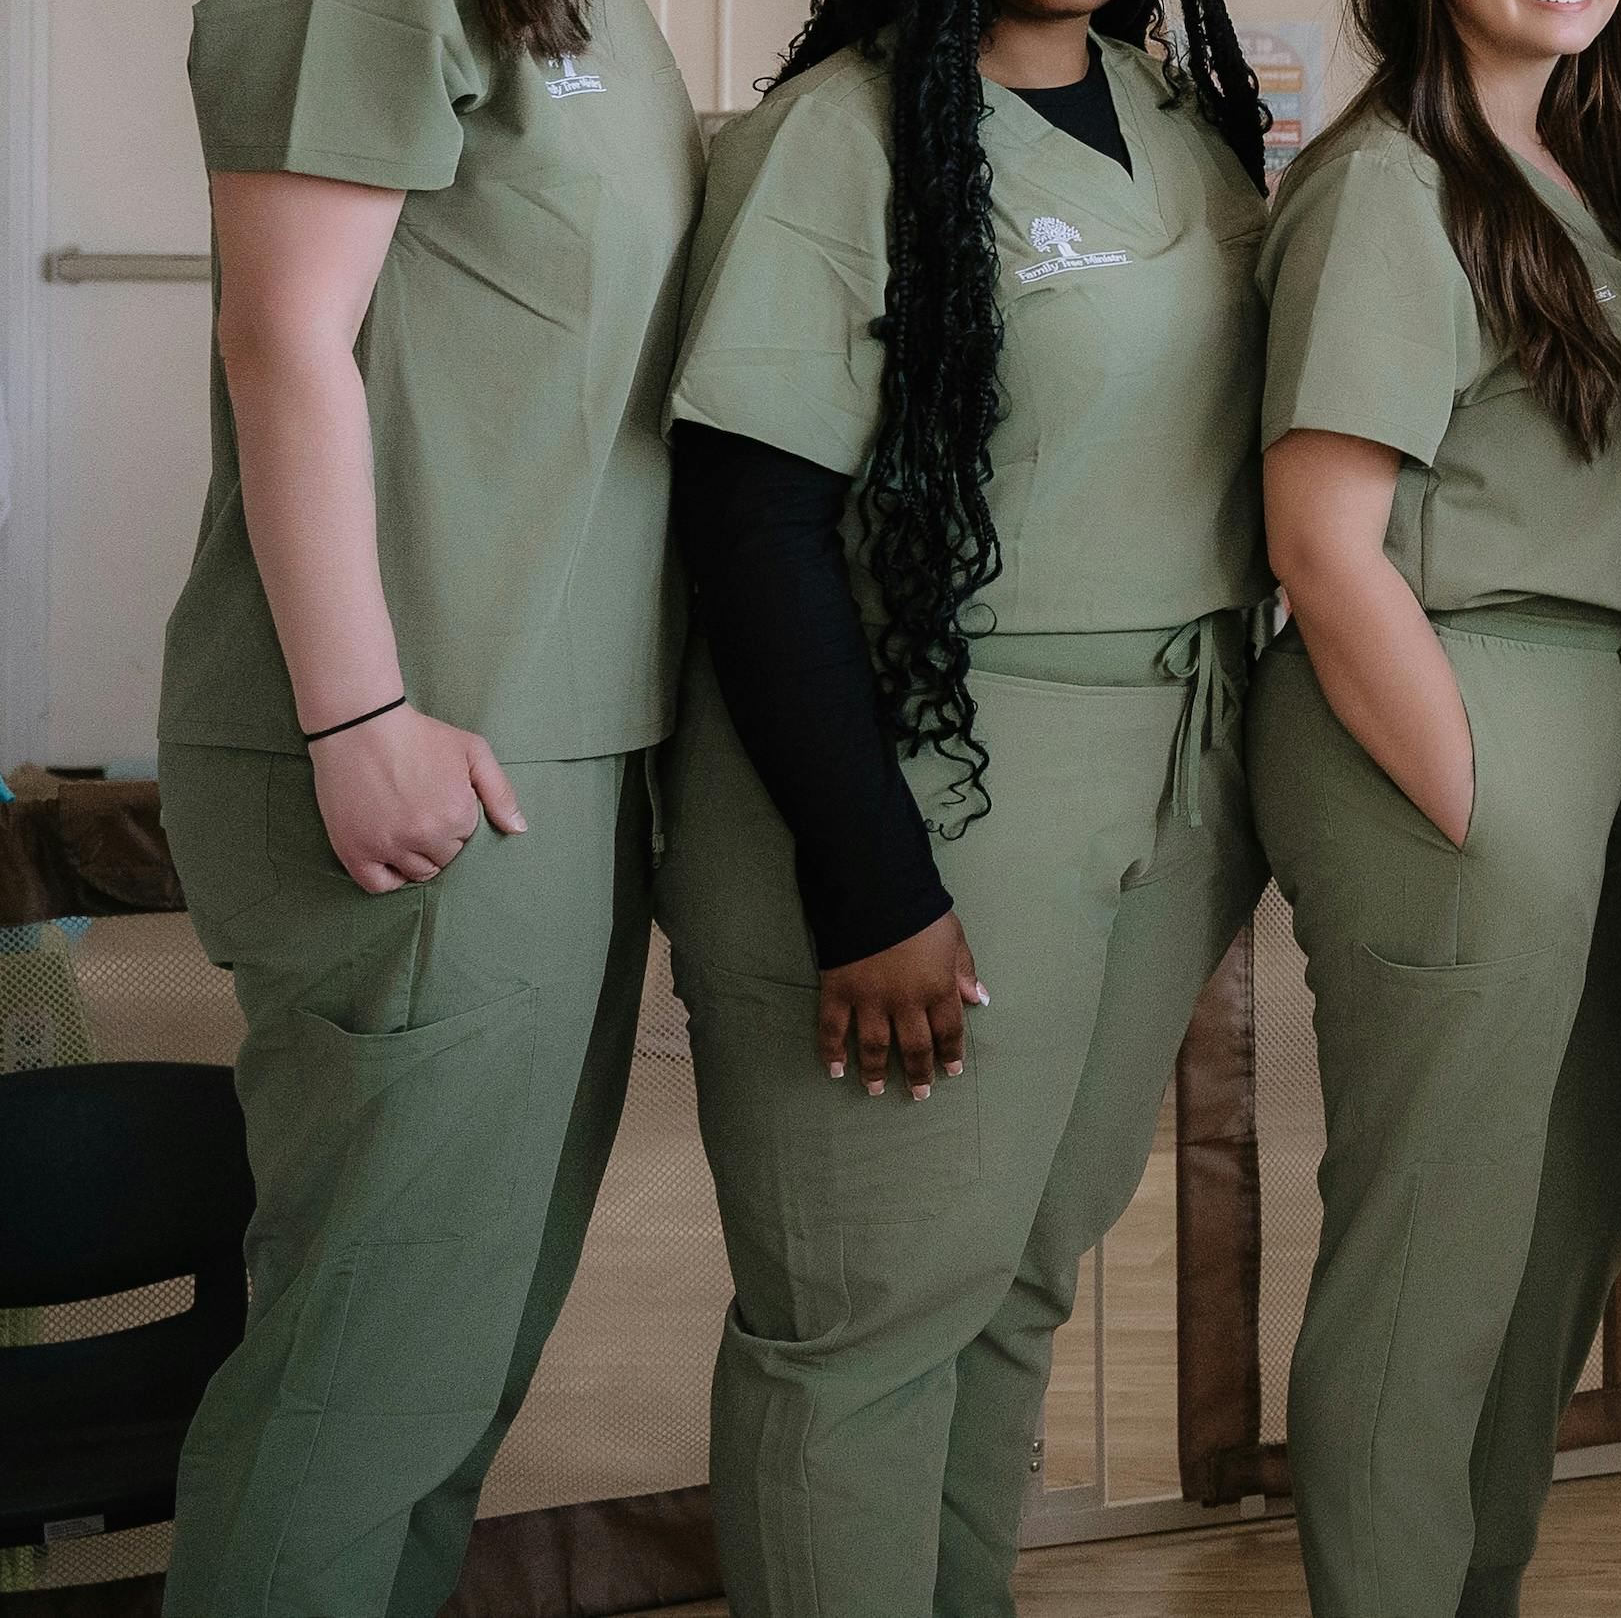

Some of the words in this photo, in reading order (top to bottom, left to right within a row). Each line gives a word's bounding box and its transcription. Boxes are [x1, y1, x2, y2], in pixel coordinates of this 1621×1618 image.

[1018, 262, 1059, 280] Family
[1058, 258, 1083, 268] Tree
[1083, 254, 1127, 265] Ministry
